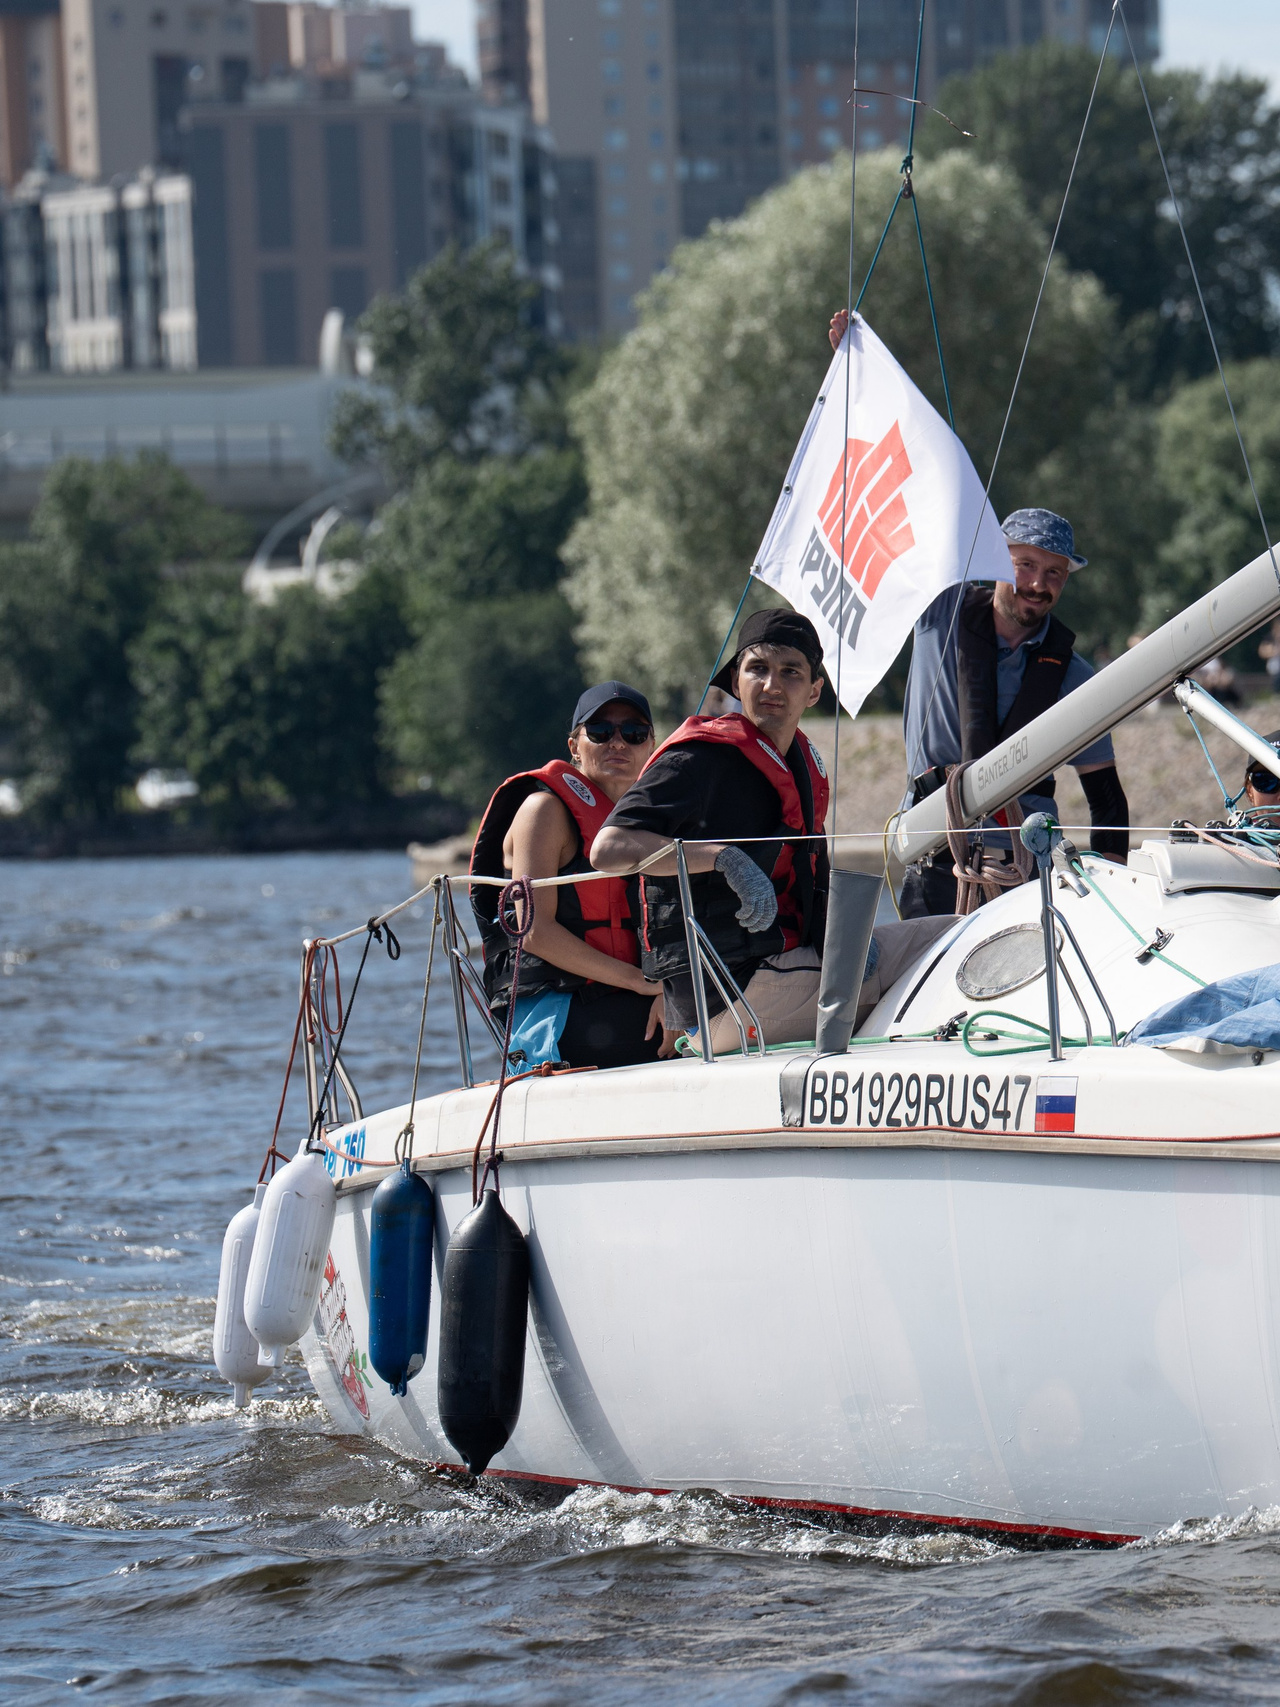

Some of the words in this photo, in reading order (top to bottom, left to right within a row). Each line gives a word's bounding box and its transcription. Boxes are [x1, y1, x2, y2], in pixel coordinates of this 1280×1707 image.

[1009, 736, 1028, 770] 760
[809, 1071, 1031, 1131] BB1929RUS47
[342, 1125, 366, 1177] 760
